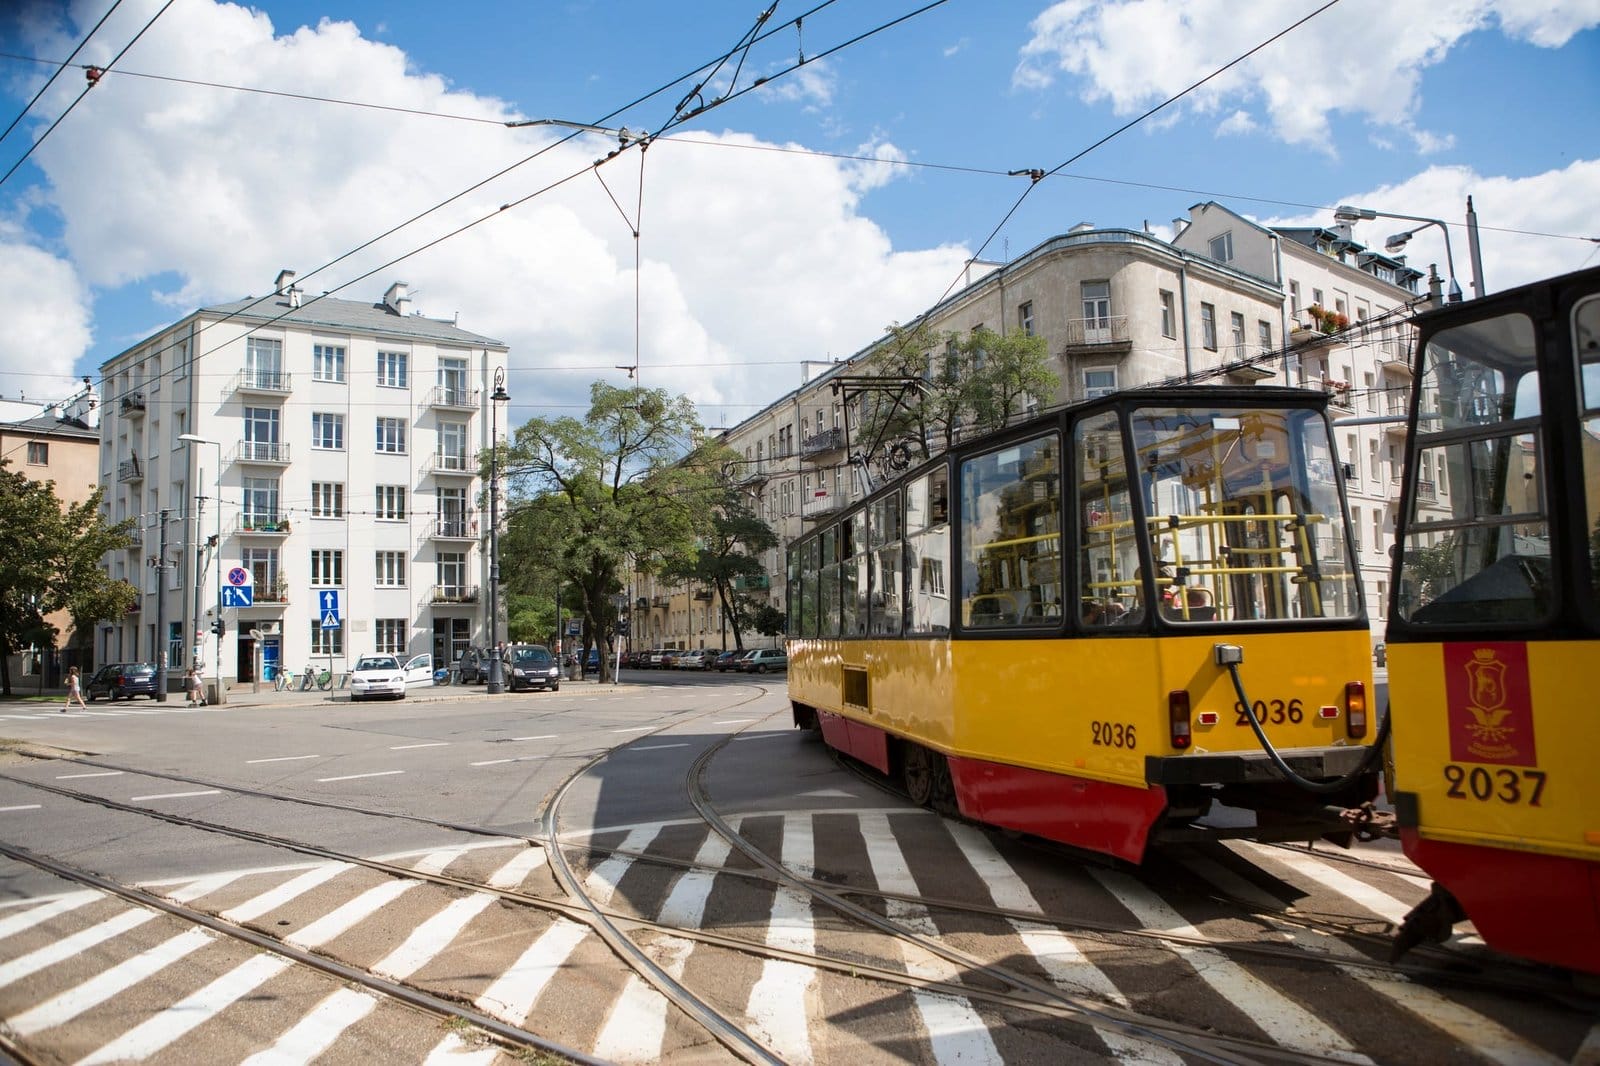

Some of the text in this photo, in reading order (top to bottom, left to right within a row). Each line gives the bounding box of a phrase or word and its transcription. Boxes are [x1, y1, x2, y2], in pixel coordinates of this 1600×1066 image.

[1234, 699, 1303, 726] 2036
[1091, 721, 1137, 750] 2036
[1444, 765, 1547, 807] 2037
